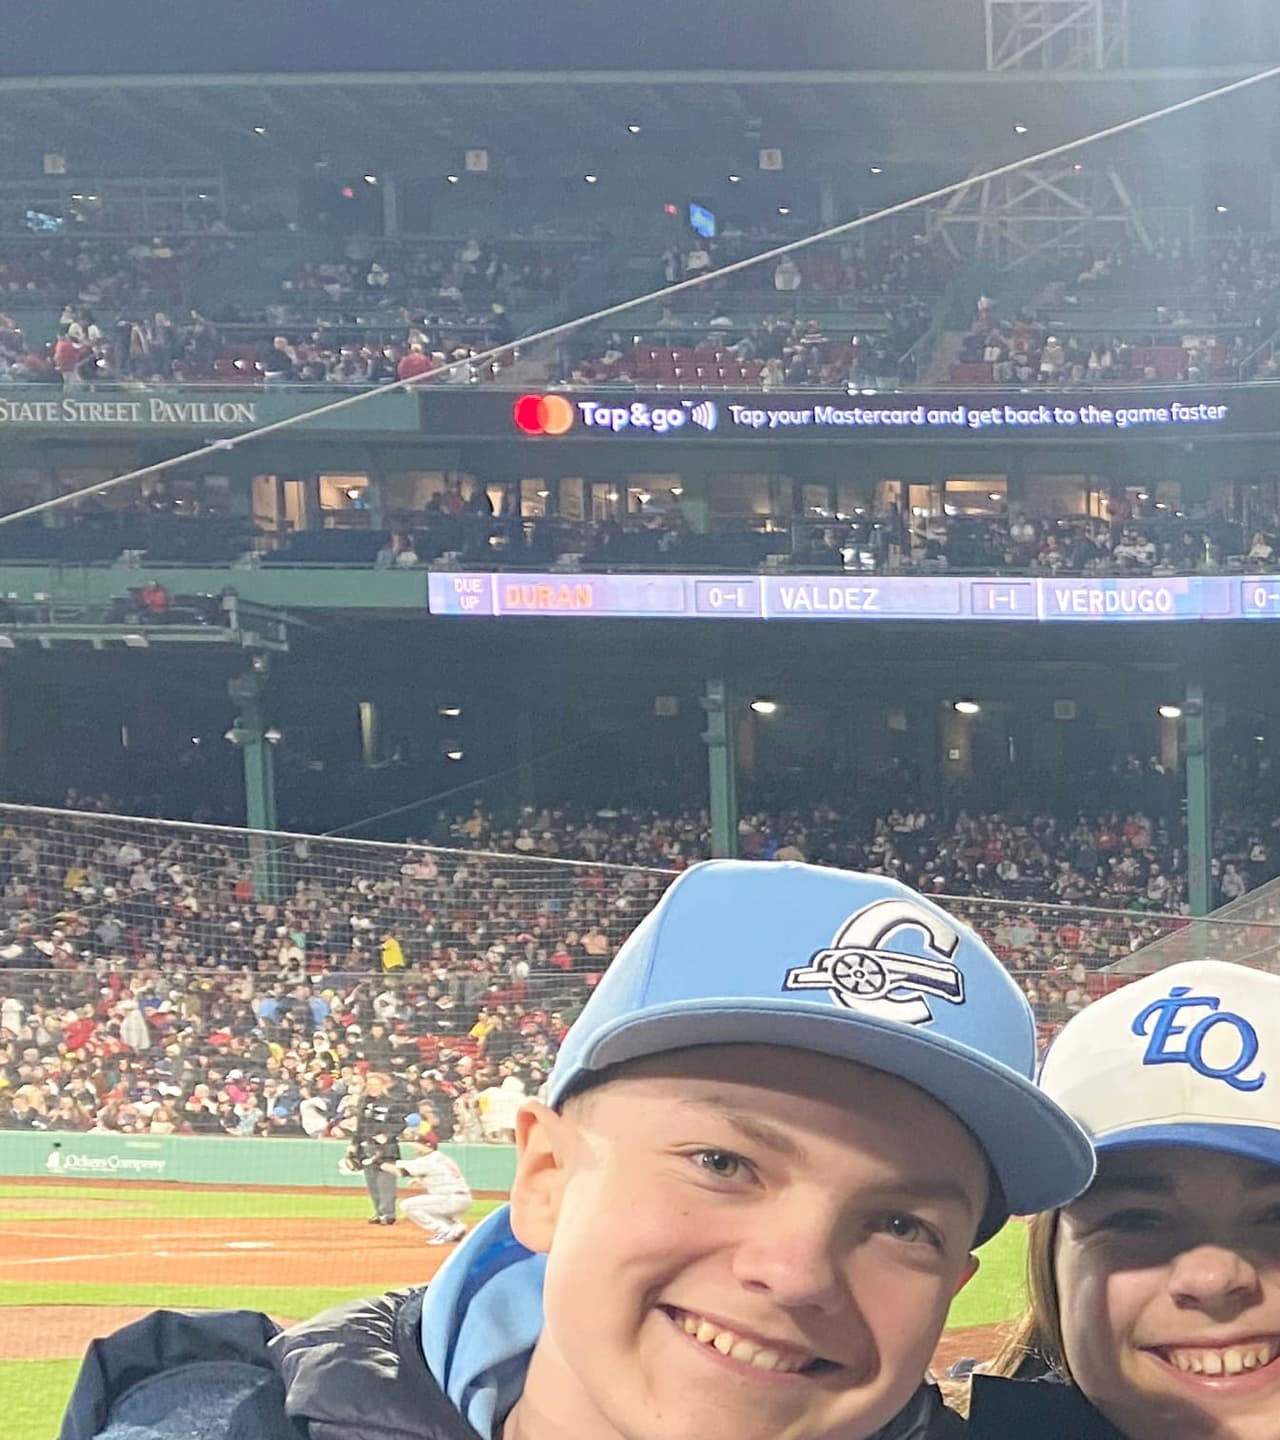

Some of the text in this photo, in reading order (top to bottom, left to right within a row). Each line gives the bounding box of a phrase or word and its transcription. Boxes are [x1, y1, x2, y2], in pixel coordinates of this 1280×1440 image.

[0, 398, 258, 423] STATE STREET PAVILION
[729, 402, 1227, 430] Tap your Mastercard and get back to the game faster
[453, 578, 483, 593] DUE
[505, 584, 593, 608] DURAN
[459, 595, 480, 610] UP
[779, 587, 880, 610] VALDEZ
[1055, 588, 1172, 613] VERDUGO
